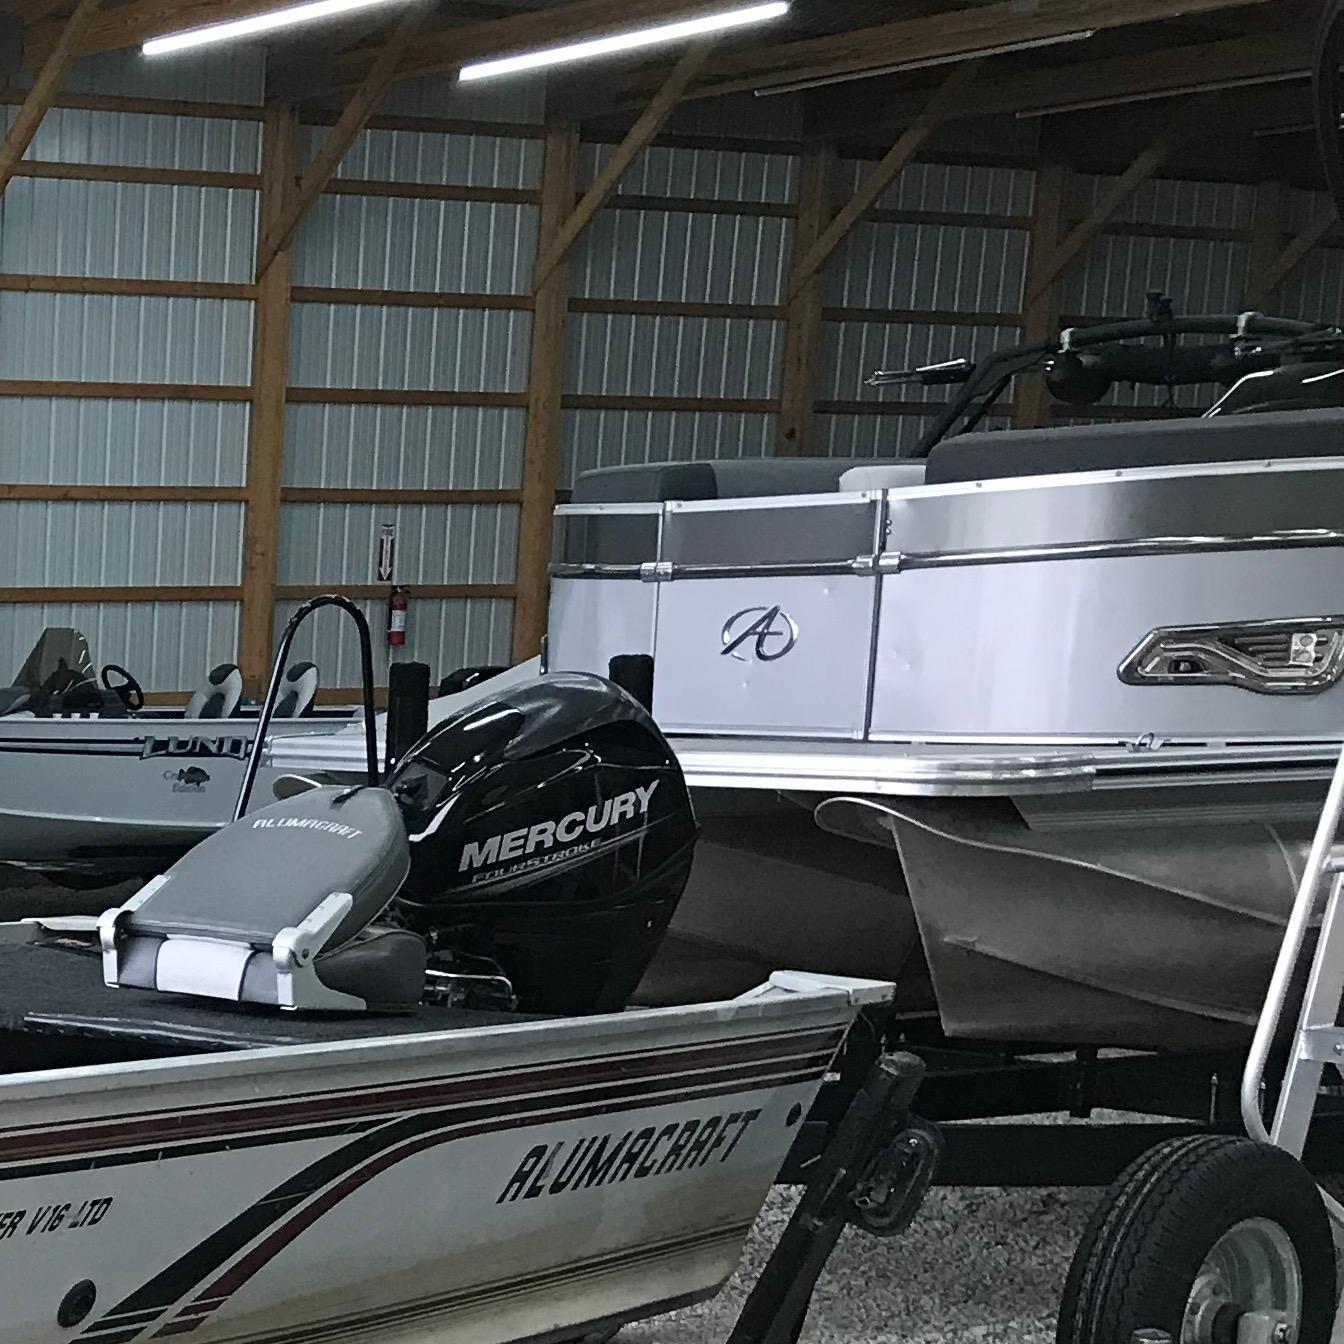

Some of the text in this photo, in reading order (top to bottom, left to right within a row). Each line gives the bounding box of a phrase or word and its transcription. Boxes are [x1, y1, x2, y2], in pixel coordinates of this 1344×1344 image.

[139, 735, 249, 761] LUND
[458, 779, 660, 873] MERCURY
[471, 837, 602, 884] FOURSTROKE
[495, 1108, 763, 1205] ALUMACRAFT
[25, 1202, 73, 1236] V16
